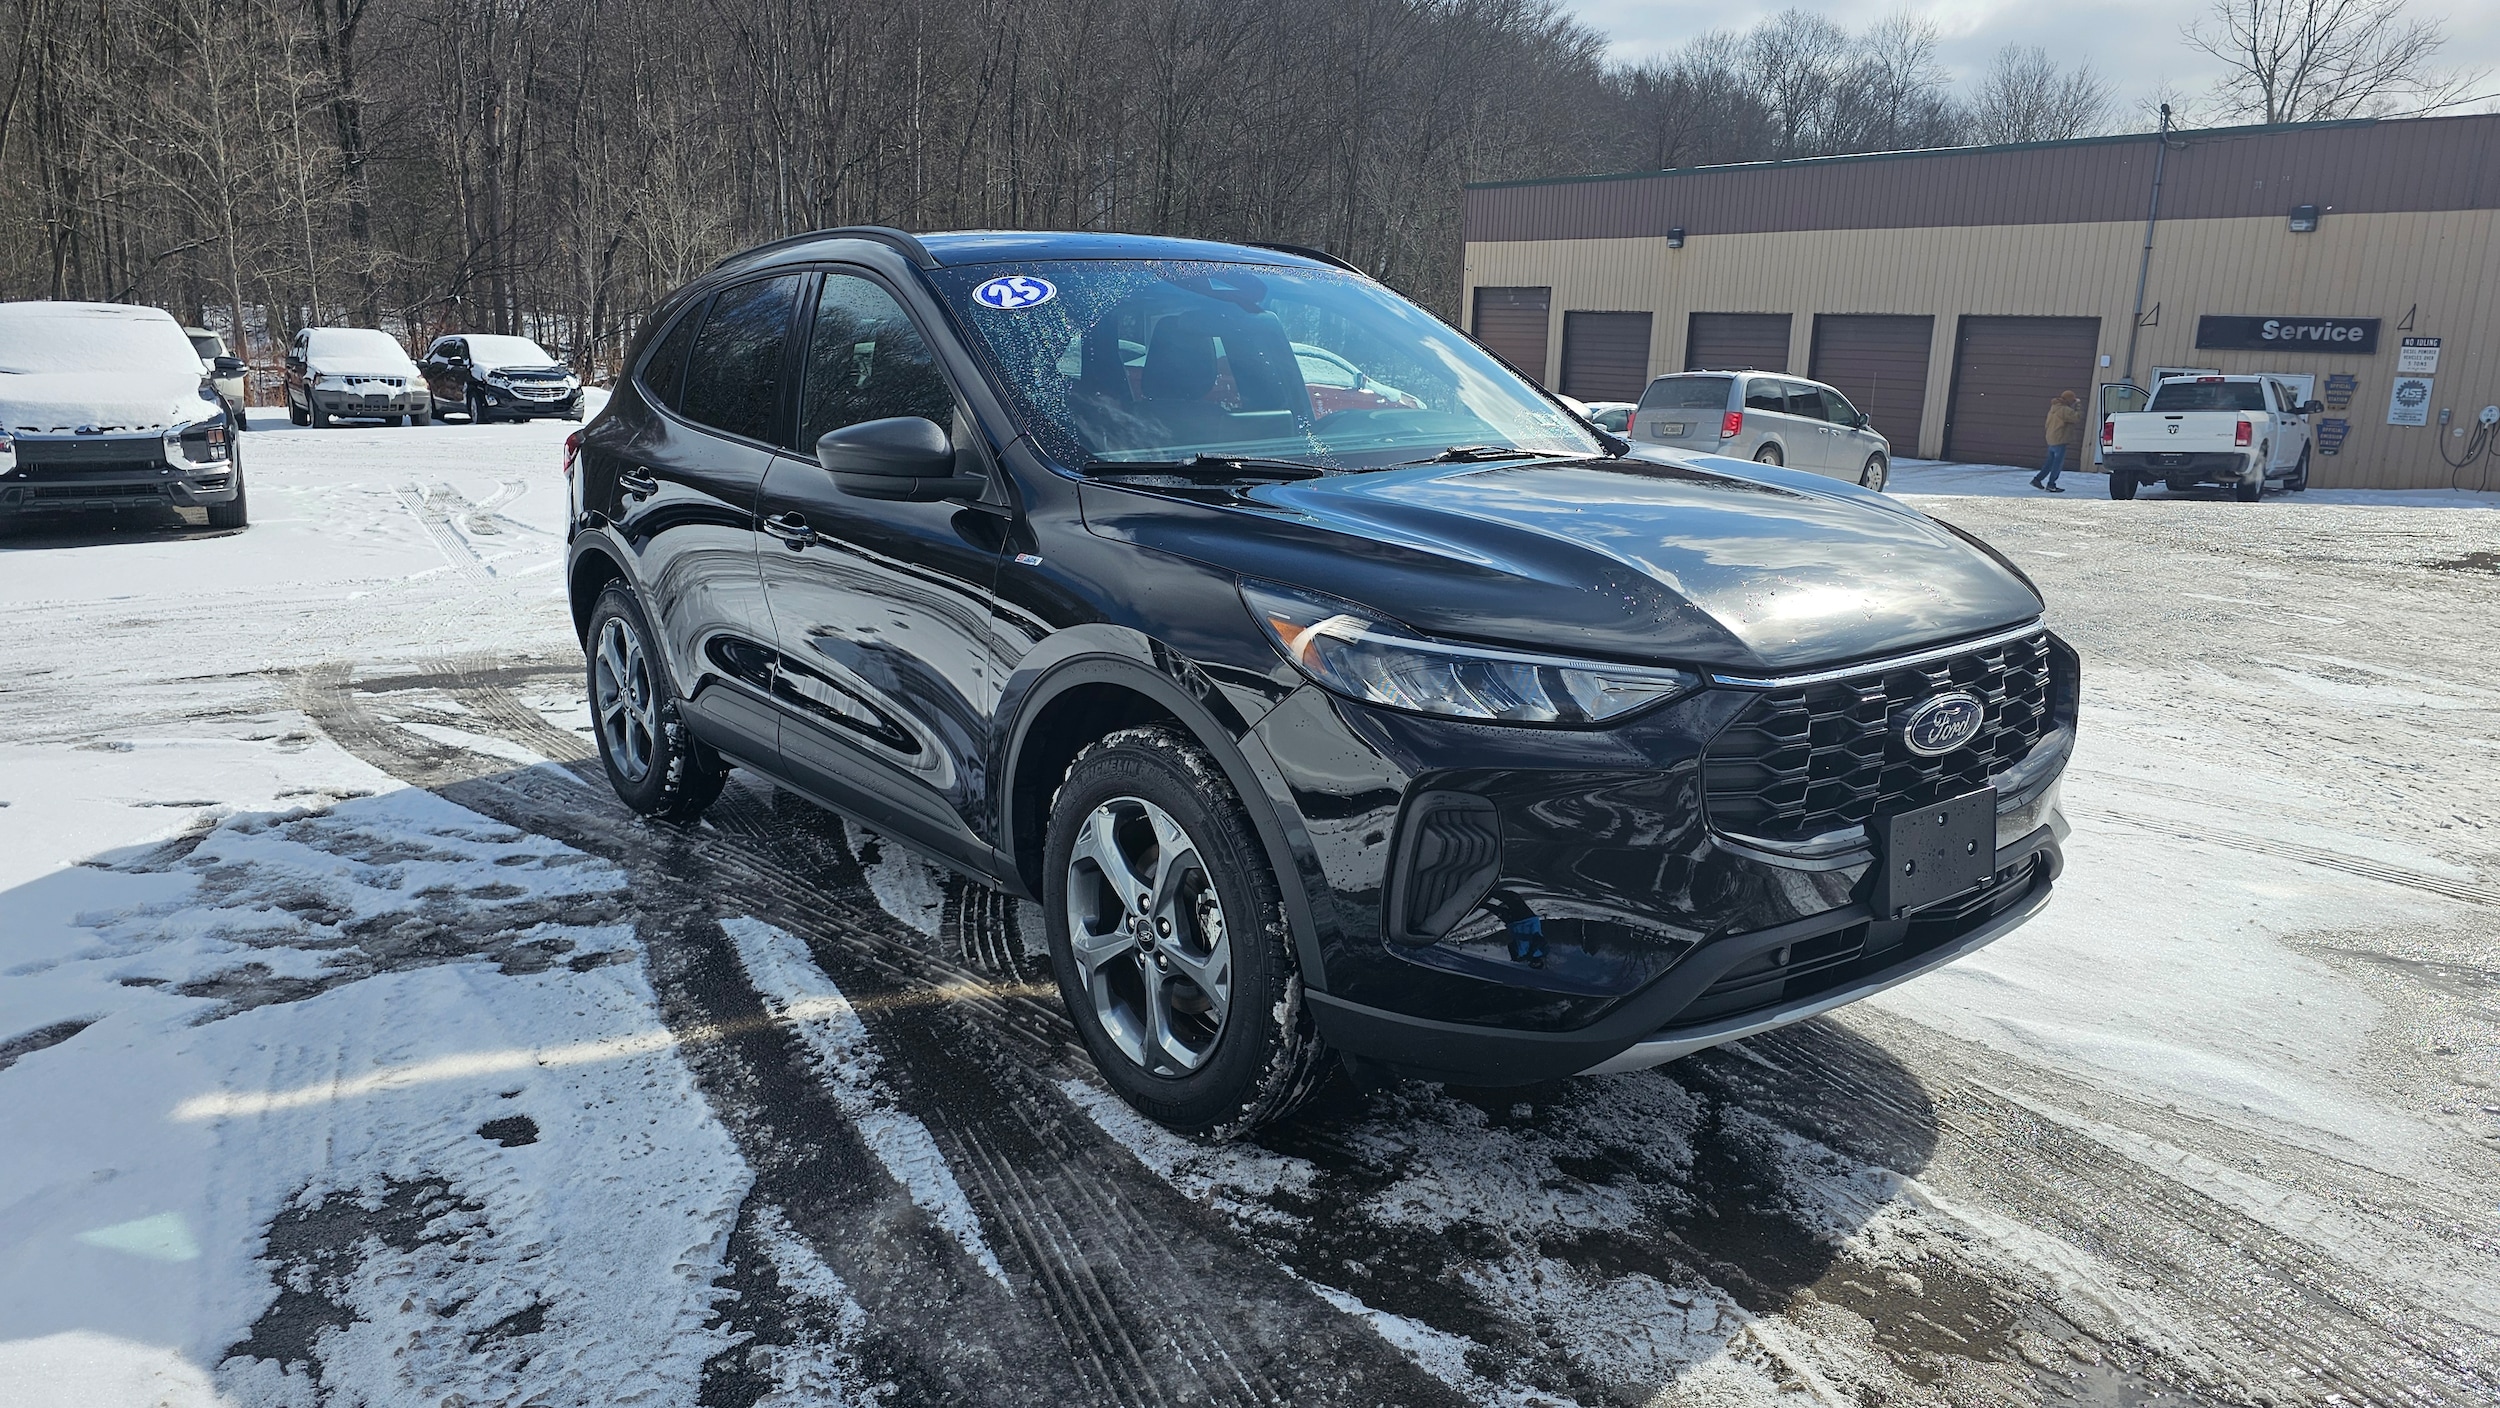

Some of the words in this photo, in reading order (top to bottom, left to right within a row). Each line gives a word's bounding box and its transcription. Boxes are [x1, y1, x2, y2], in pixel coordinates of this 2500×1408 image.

[988, 277, 1041, 307] 25
[2261, 319, 2364, 342] Service
[2404, 338, 2415, 347] NO
[2416, 338, 2438, 347] IDLING
[2400, 388, 2424, 398] ASE
[1927, 706, 1971, 744] Ford
[1080, 759, 1140, 785] MICHELIN
